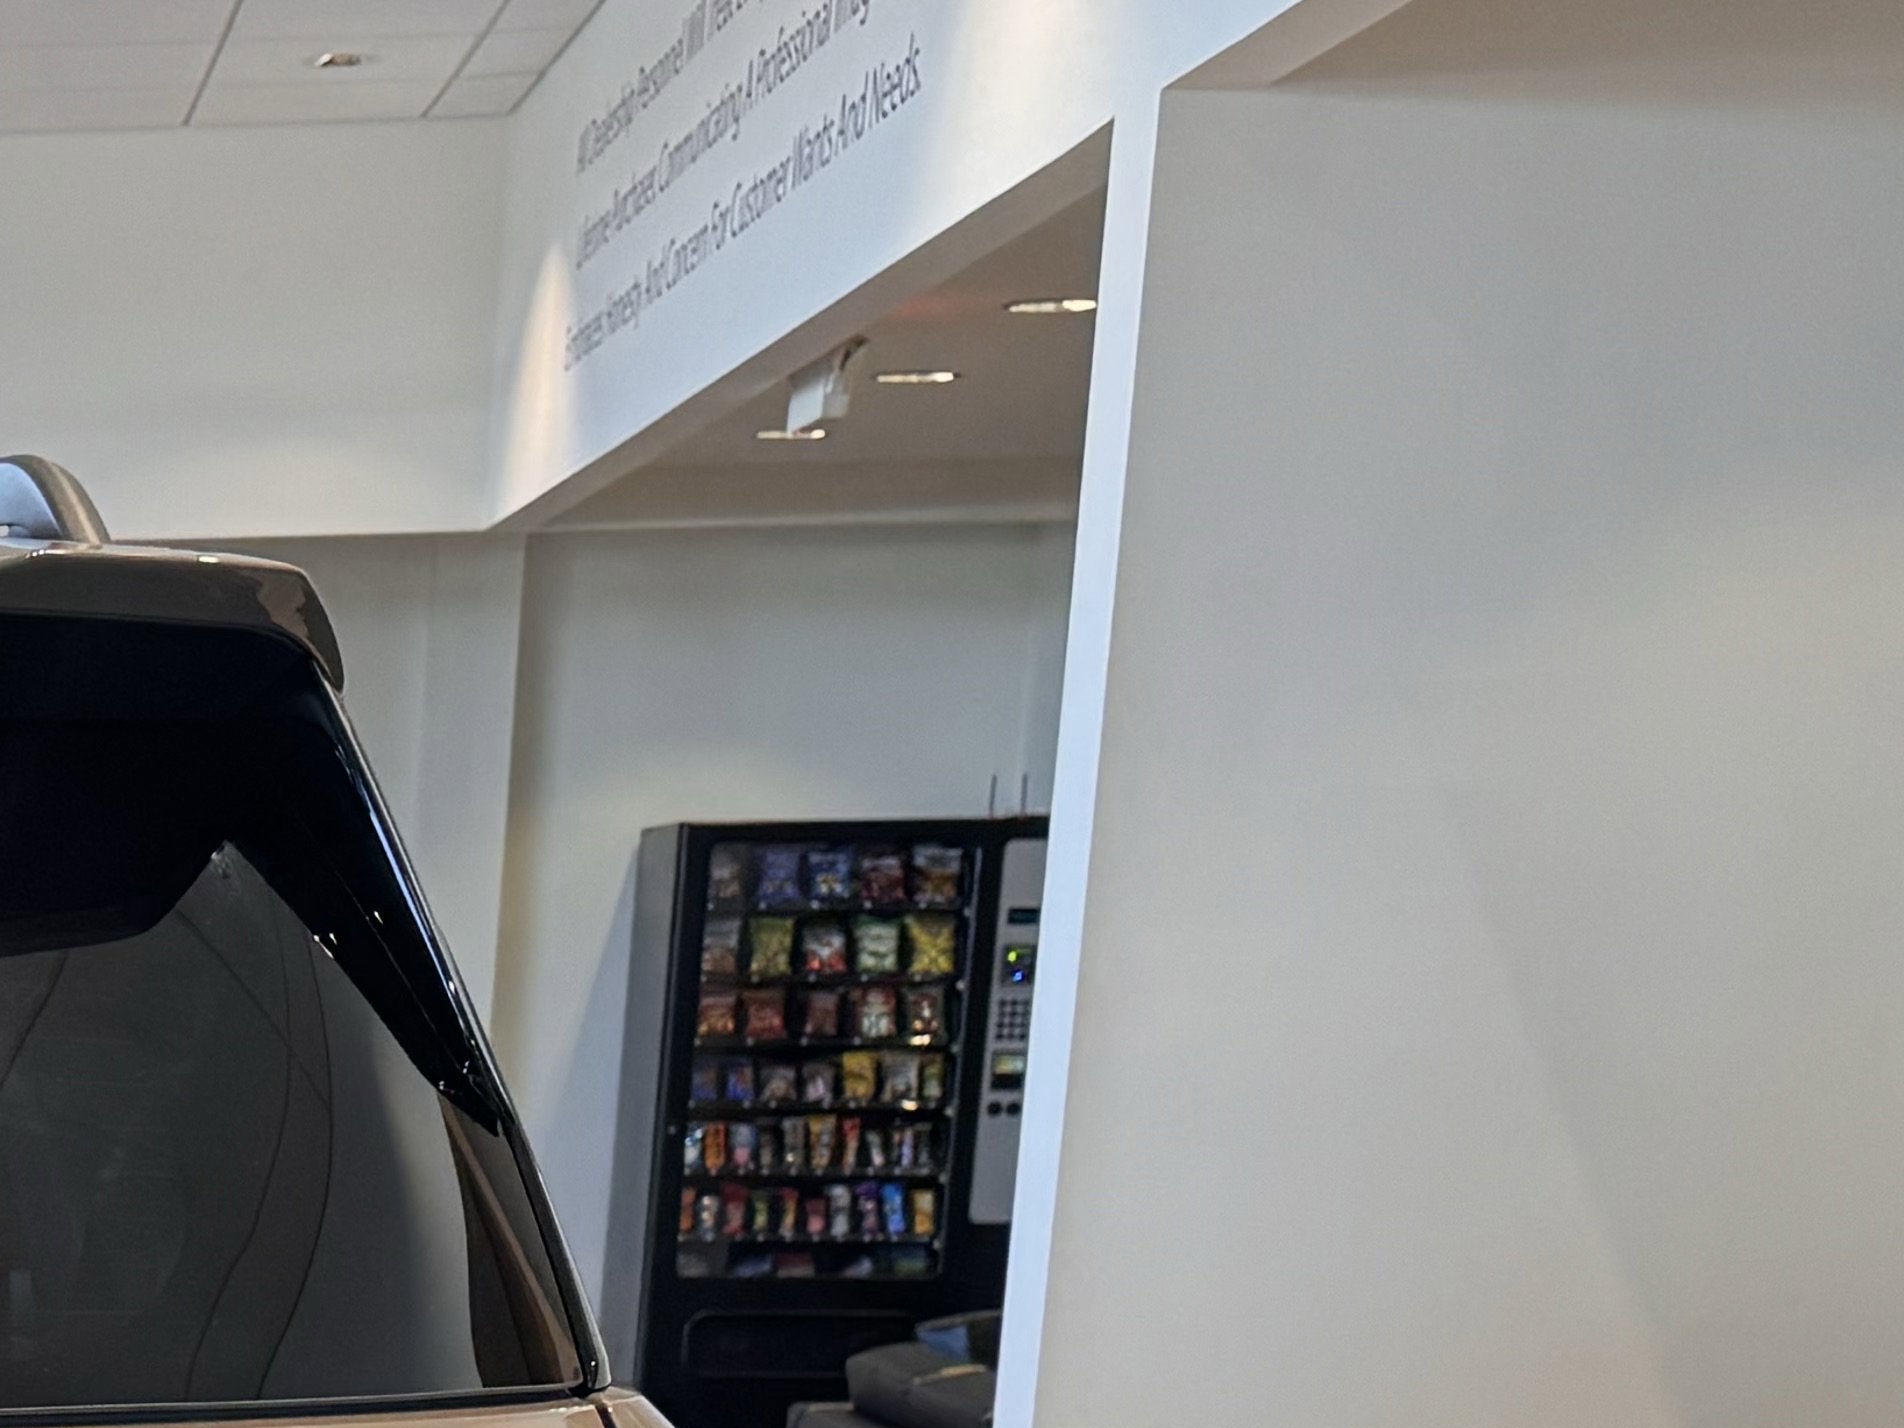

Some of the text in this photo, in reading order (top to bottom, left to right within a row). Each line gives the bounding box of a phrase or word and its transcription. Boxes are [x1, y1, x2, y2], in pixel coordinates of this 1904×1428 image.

[730, 180, 792, 240] Customer
[791, 113, 835, 190] Wants
[834, 70, 870, 157] And
[868, 31, 922, 130] Needs
